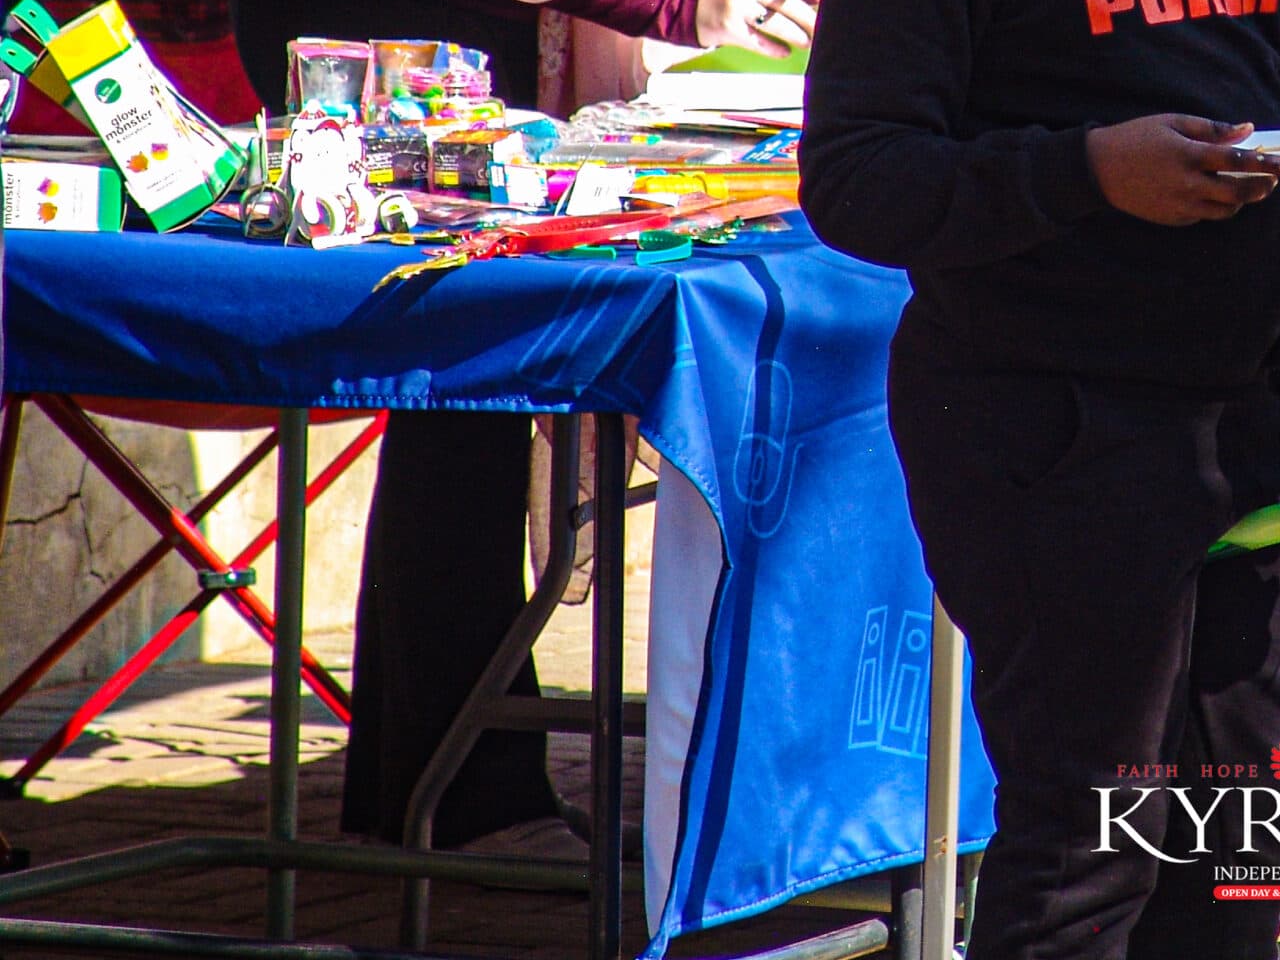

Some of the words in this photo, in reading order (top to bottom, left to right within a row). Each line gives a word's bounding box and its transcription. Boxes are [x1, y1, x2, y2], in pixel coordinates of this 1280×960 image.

[105, 110, 152, 141] monster
[111, 107, 138, 128] glow
[5, 173, 14, 225] monster
